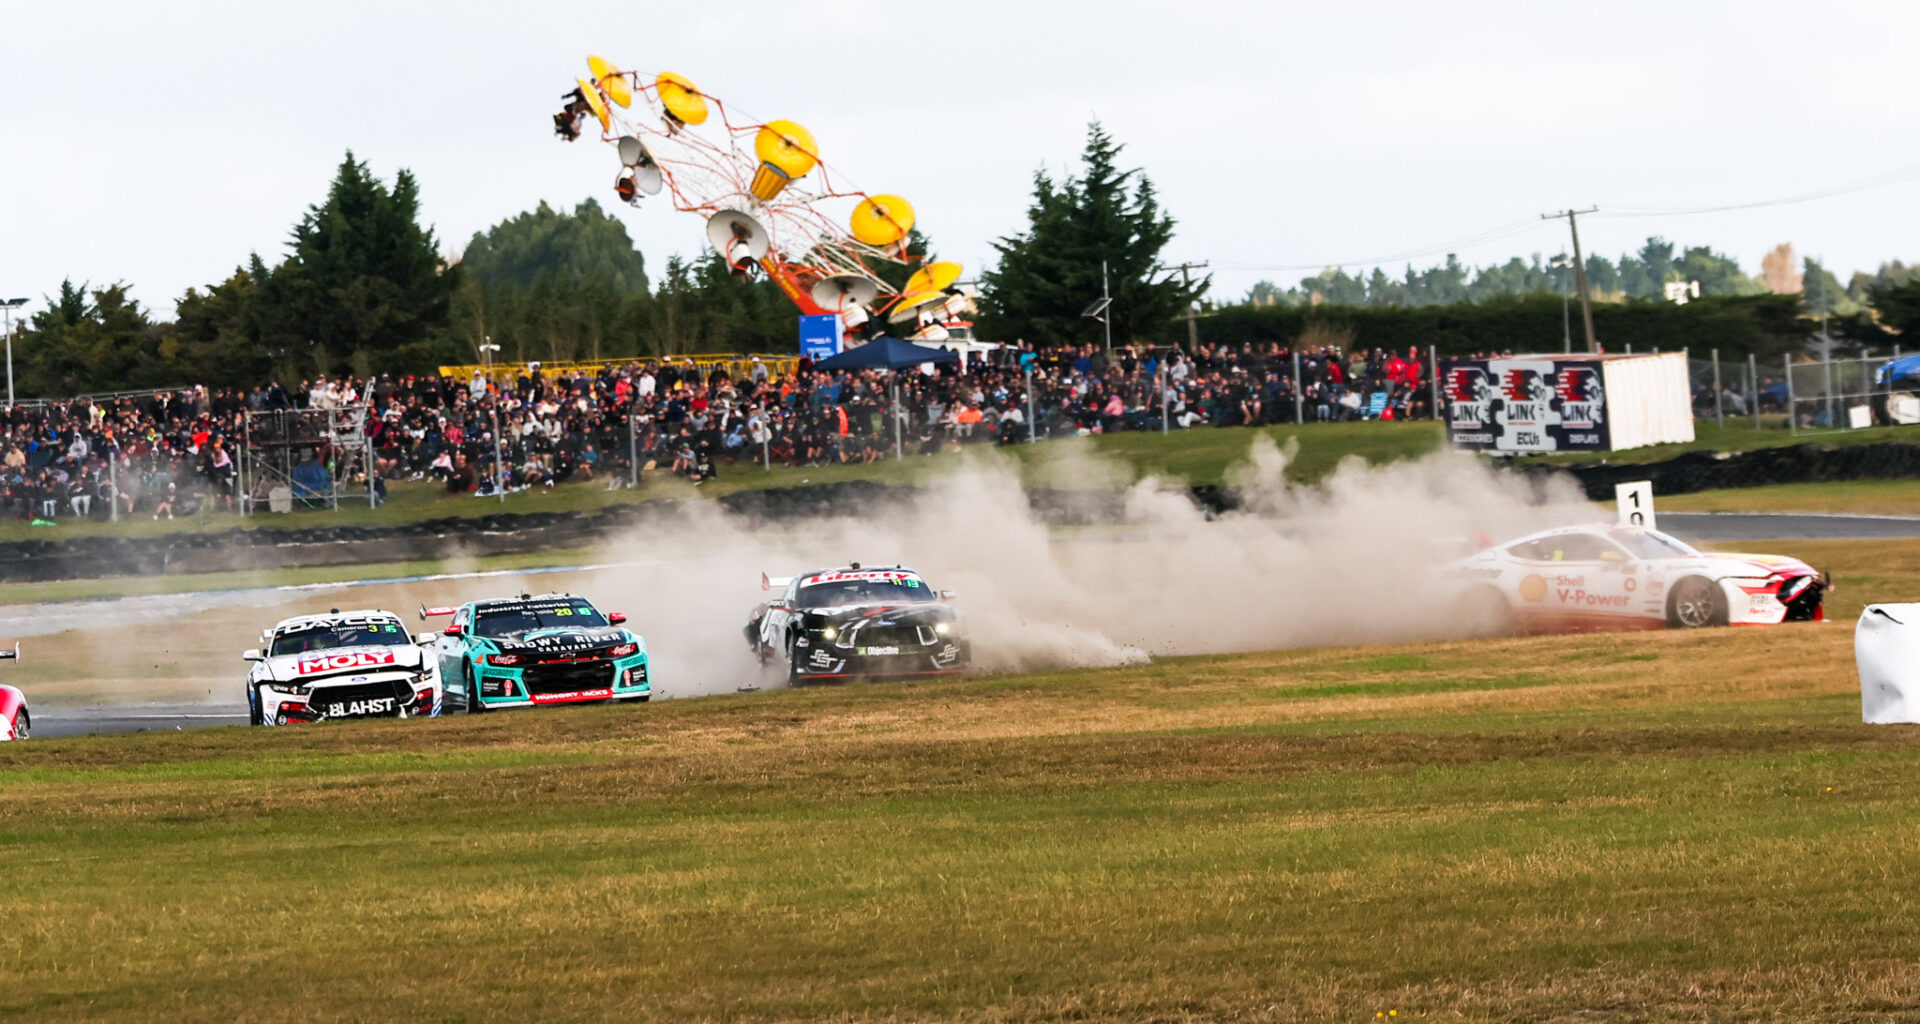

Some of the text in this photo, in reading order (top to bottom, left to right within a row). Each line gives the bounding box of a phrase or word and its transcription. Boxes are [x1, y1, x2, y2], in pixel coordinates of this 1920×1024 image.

[1507, 404, 1536, 420] LINK
[1517, 432, 1540, 445] ECUs
[810, 572, 911, 583] Liberty
[1557, 574, 1585, 587] Shell
[1556, 588, 1632, 607] V-Power
[555, 608, 573, 616] 20
[284, 616, 391, 634] DAYCO
[368, 625, 379, 633] 3
[503, 633, 621, 650] SNOWY RIVER
[538, 643, 594, 653] CARAVANS
[868, 646, 899, 656] Objective
[303, 653, 392, 673] MOLY
[535, 691, 578, 700] HUNGRY
[329, 697, 396, 718] BLAHST
